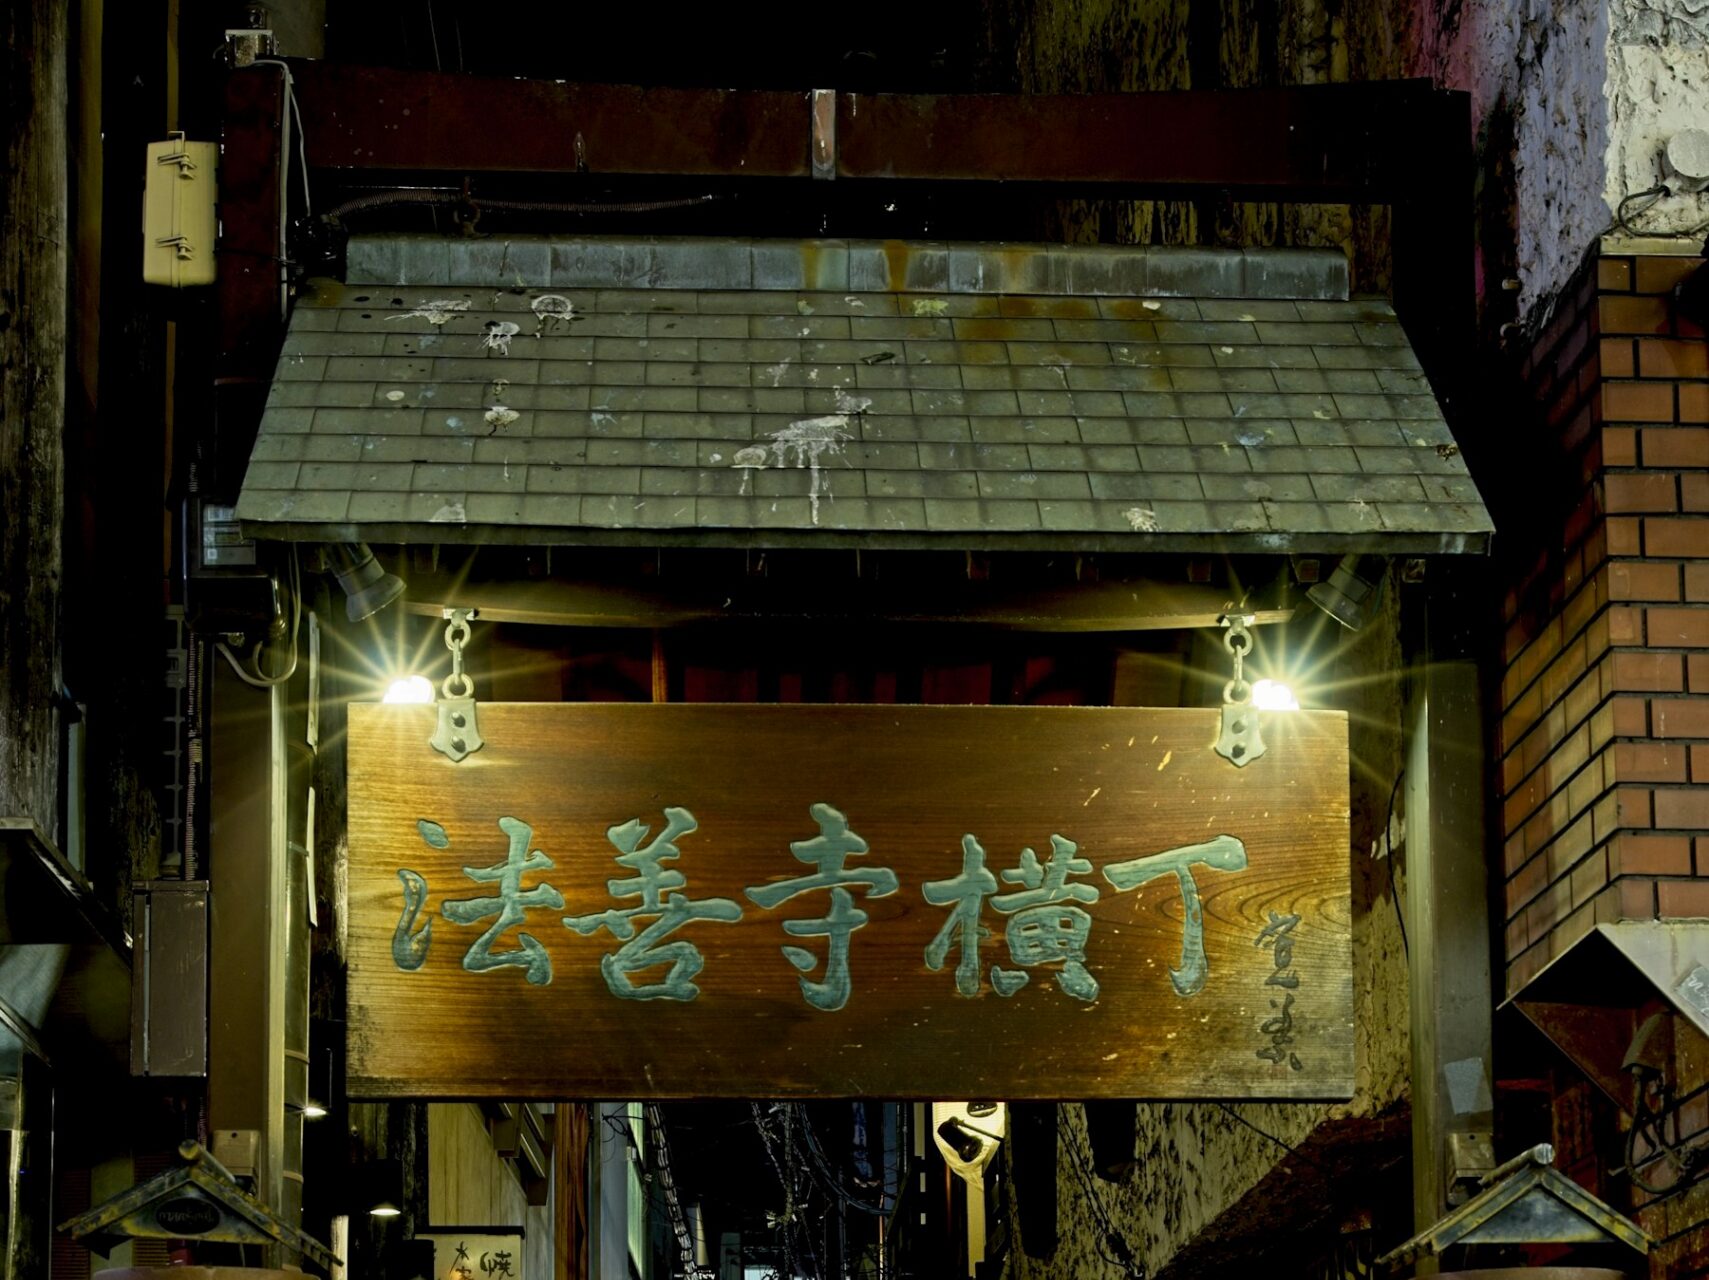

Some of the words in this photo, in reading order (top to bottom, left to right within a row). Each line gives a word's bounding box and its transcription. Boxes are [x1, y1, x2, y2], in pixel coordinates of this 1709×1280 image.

[391, 802, 1248, 1012] 法善寺横丁
